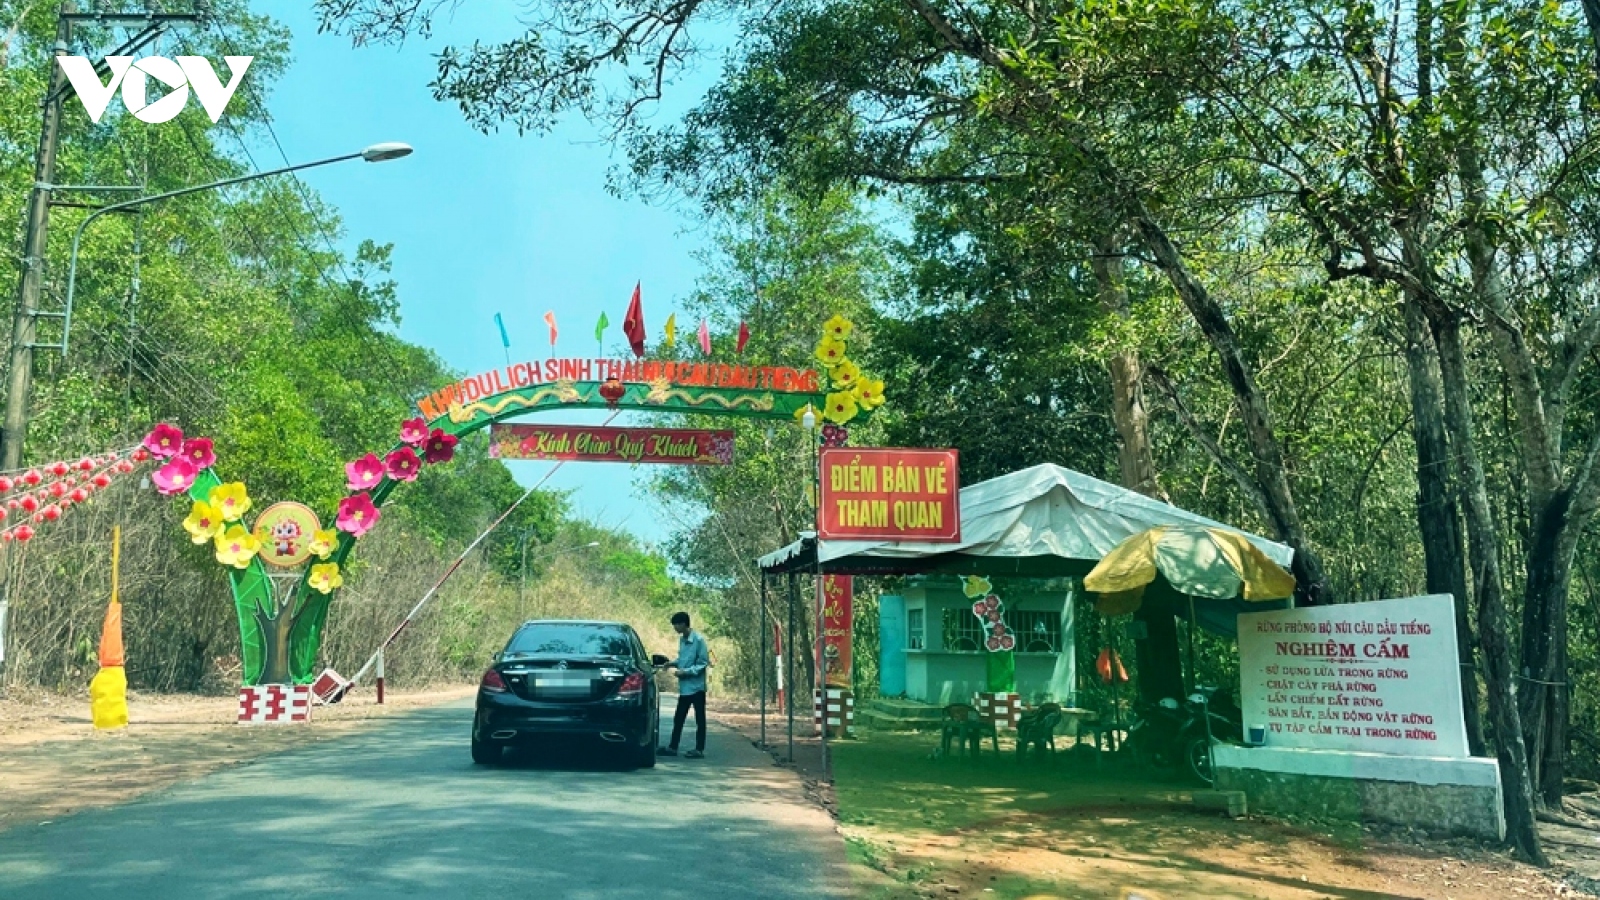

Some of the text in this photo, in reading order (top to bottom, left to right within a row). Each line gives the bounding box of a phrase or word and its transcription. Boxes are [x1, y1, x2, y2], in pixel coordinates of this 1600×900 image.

[545, 359, 591, 381] SINH
[529, 431, 700, 460] Kính Chào Quý Khách
[831, 454, 948, 494] ĐIỂM BÁN VÉ
[837, 499, 943, 531] THAM QUAN
[1400, 617, 1431, 635] TIẾNG
[1275, 637, 1410, 659] NGHIÊM CẤM
[1338, 667, 1374, 678] TRONG
[1377, 667, 1409, 680] RỪNG
[1346, 681, 1377, 693] RỪNG
[1353, 696, 1383, 708] RỪNG
[1401, 712, 1433, 725] RỪNG
[1365, 727, 1402, 739] TRONG
[1405, 727, 1437, 741] RỪNG
